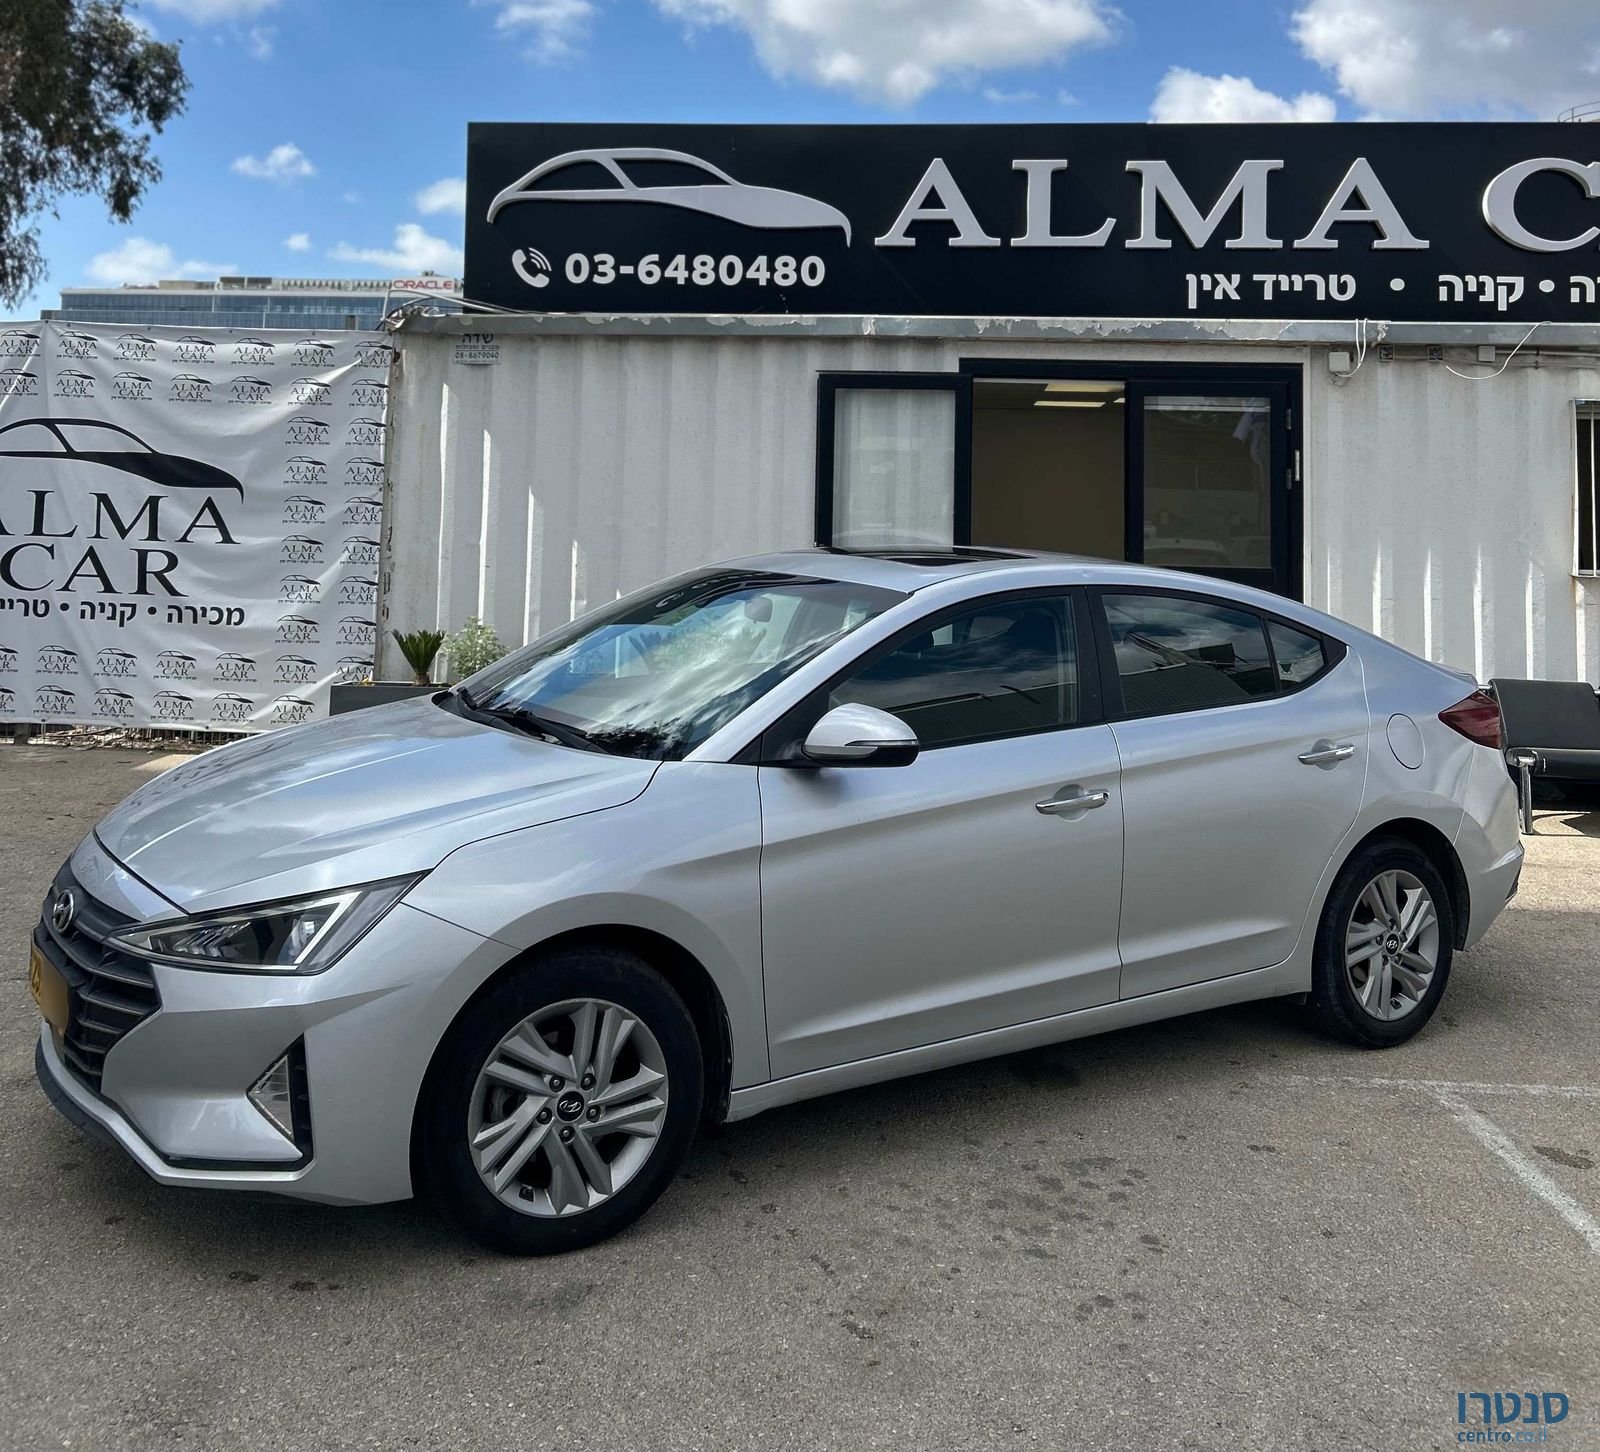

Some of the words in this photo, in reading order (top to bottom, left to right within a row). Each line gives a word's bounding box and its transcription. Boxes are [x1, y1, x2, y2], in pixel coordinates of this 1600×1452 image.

[874, 157, 1430, 250] ALMA
[565, 252, 826, 287] 03-6480480
[393, 279, 453, 290] ORACLE
[1253, 273, 1357, 301] טרייד
[1186, 273, 1241, 310] אין
[1438, 275, 1525, 312] קניה
[1, 339, 40, 347] ALMA
[59, 341, 97, 349] ALMA
[117, 343, 156, 351] ALMA
[6, 346, 33, 354] CAR
[65, 348, 90, 356] CAR
[175, 345, 216, 354] ALMA
[234, 347, 273, 355] ALMA
[294, 348, 334, 357] ALMA
[122, 350, 147, 358] CAR
[181, 352, 206, 360] CAR
[240, 354, 266, 362] CAR
[360, 357, 387, 365] CAR
[56, 380, 94, 388] ALMA
[113, 382, 152, 390] ALMA
[171, 383, 212, 392] ALMA
[4, 385, 30, 393] CAR
[62, 386, 87, 394] CAR
[119, 389, 144, 397] CAR
[231, 386, 271, 394] ALMA
[290, 387, 330, 395] ALMA
[177, 391, 202, 399] CAR
[237, 393, 263, 401] CAR
[296, 394, 323, 402] CAR
[358, 396, 383, 404] CAR
[287, 426, 329, 435] ALMA
[286, 466, 326, 474] ALMA
[292, 473, 318, 481] CAR
[353, 474, 379, 482] CAR
[284, 505, 325, 513] ALMA
[0, 489, 242, 545] LMA
[351, 514, 378, 522] CAR
[281, 545, 323, 553] ALMA
[348, 553, 375, 561] CAR
[0, 542, 189, 597] CAR
[280, 585, 319, 593] ALMA
[286, 592, 312, 600] CAR
[79, 600, 137, 628] קניה
[167, 604, 245, 626] מכירה
[277, 625, 318, 633] ALMA
[284, 632, 310, 640] CAR
[38, 655, 78, 664] ALMA
[96, 658, 136, 666] ALMA
[44, 662, 70, 670] CAR
[156, 660, 196, 669] ALMA
[216, 663, 256, 671] ALMA
[103, 665, 129, 674] CAR
[162, 668, 188, 676] CAR
[276, 665, 316, 673] ALMA
[222, 670, 248, 678] CAR
[36, 696, 74, 704] ALMA
[94, 698, 133, 706] ALMA
[154, 700, 193, 709] ALMA
[213, 703, 253, 712] ALMA
[100, 705, 126, 713] CAR
[159, 708, 186, 716] CAR
[273, 705, 313, 713] ALMA
